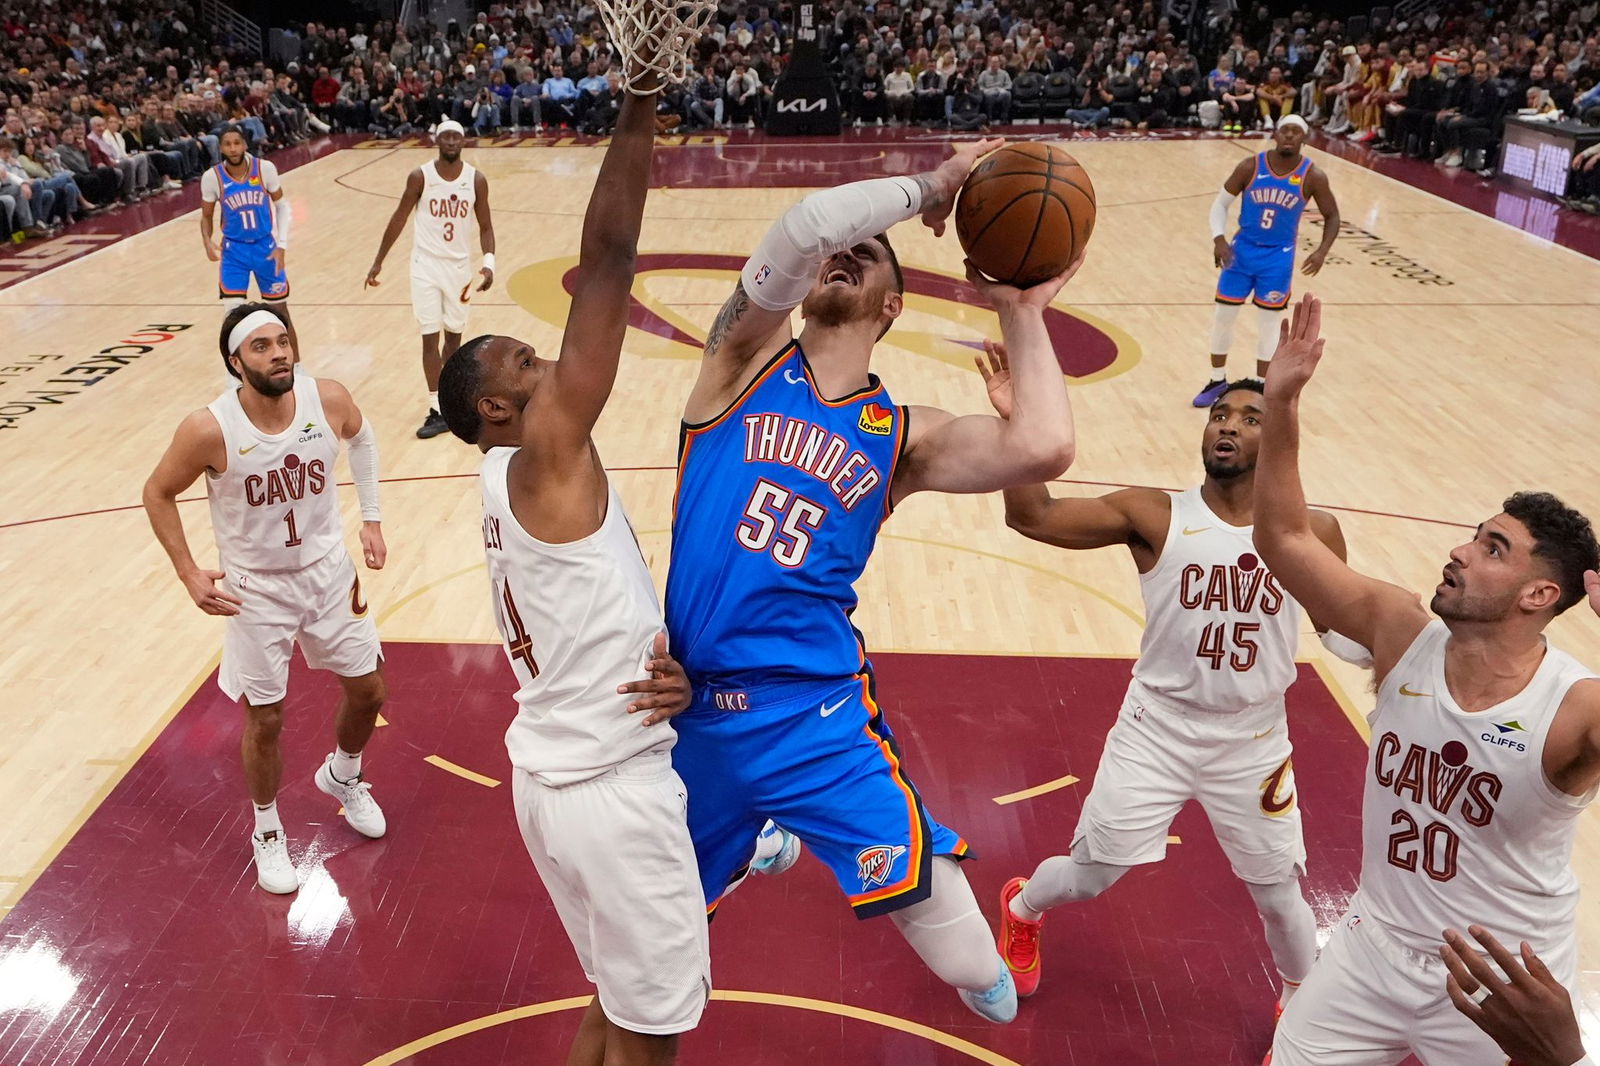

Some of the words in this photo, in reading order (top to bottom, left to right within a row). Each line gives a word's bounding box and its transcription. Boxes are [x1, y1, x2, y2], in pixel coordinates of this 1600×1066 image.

[777, 98, 827, 112] KIA
[224, 190, 265, 211] THUNDER
[429, 198, 469, 218] CAVS
[1250, 187, 1299, 210] THUNDER
[240, 210, 256, 230] 11
[443, 222, 454, 241] 3
[1260, 209, 1275, 229] 5
[298, 432, 323, 443] CLIFFS
[743, 413, 881, 512] THUNDER
[244, 458, 325, 507] CAVS
[283, 508, 302, 547] 1
[735, 477, 829, 568] 55
[1180, 563, 1284, 616] CAVS
[496, 576, 540, 679] 4
[1196, 621, 1261, 672] 45
[715, 692, 748, 711] OKC
[1480, 733, 1526, 752] CLIFFS
[1375, 731, 1503, 828] CAVS
[1387, 808, 1460, 882] 20
[863, 851, 884, 879] OKC
